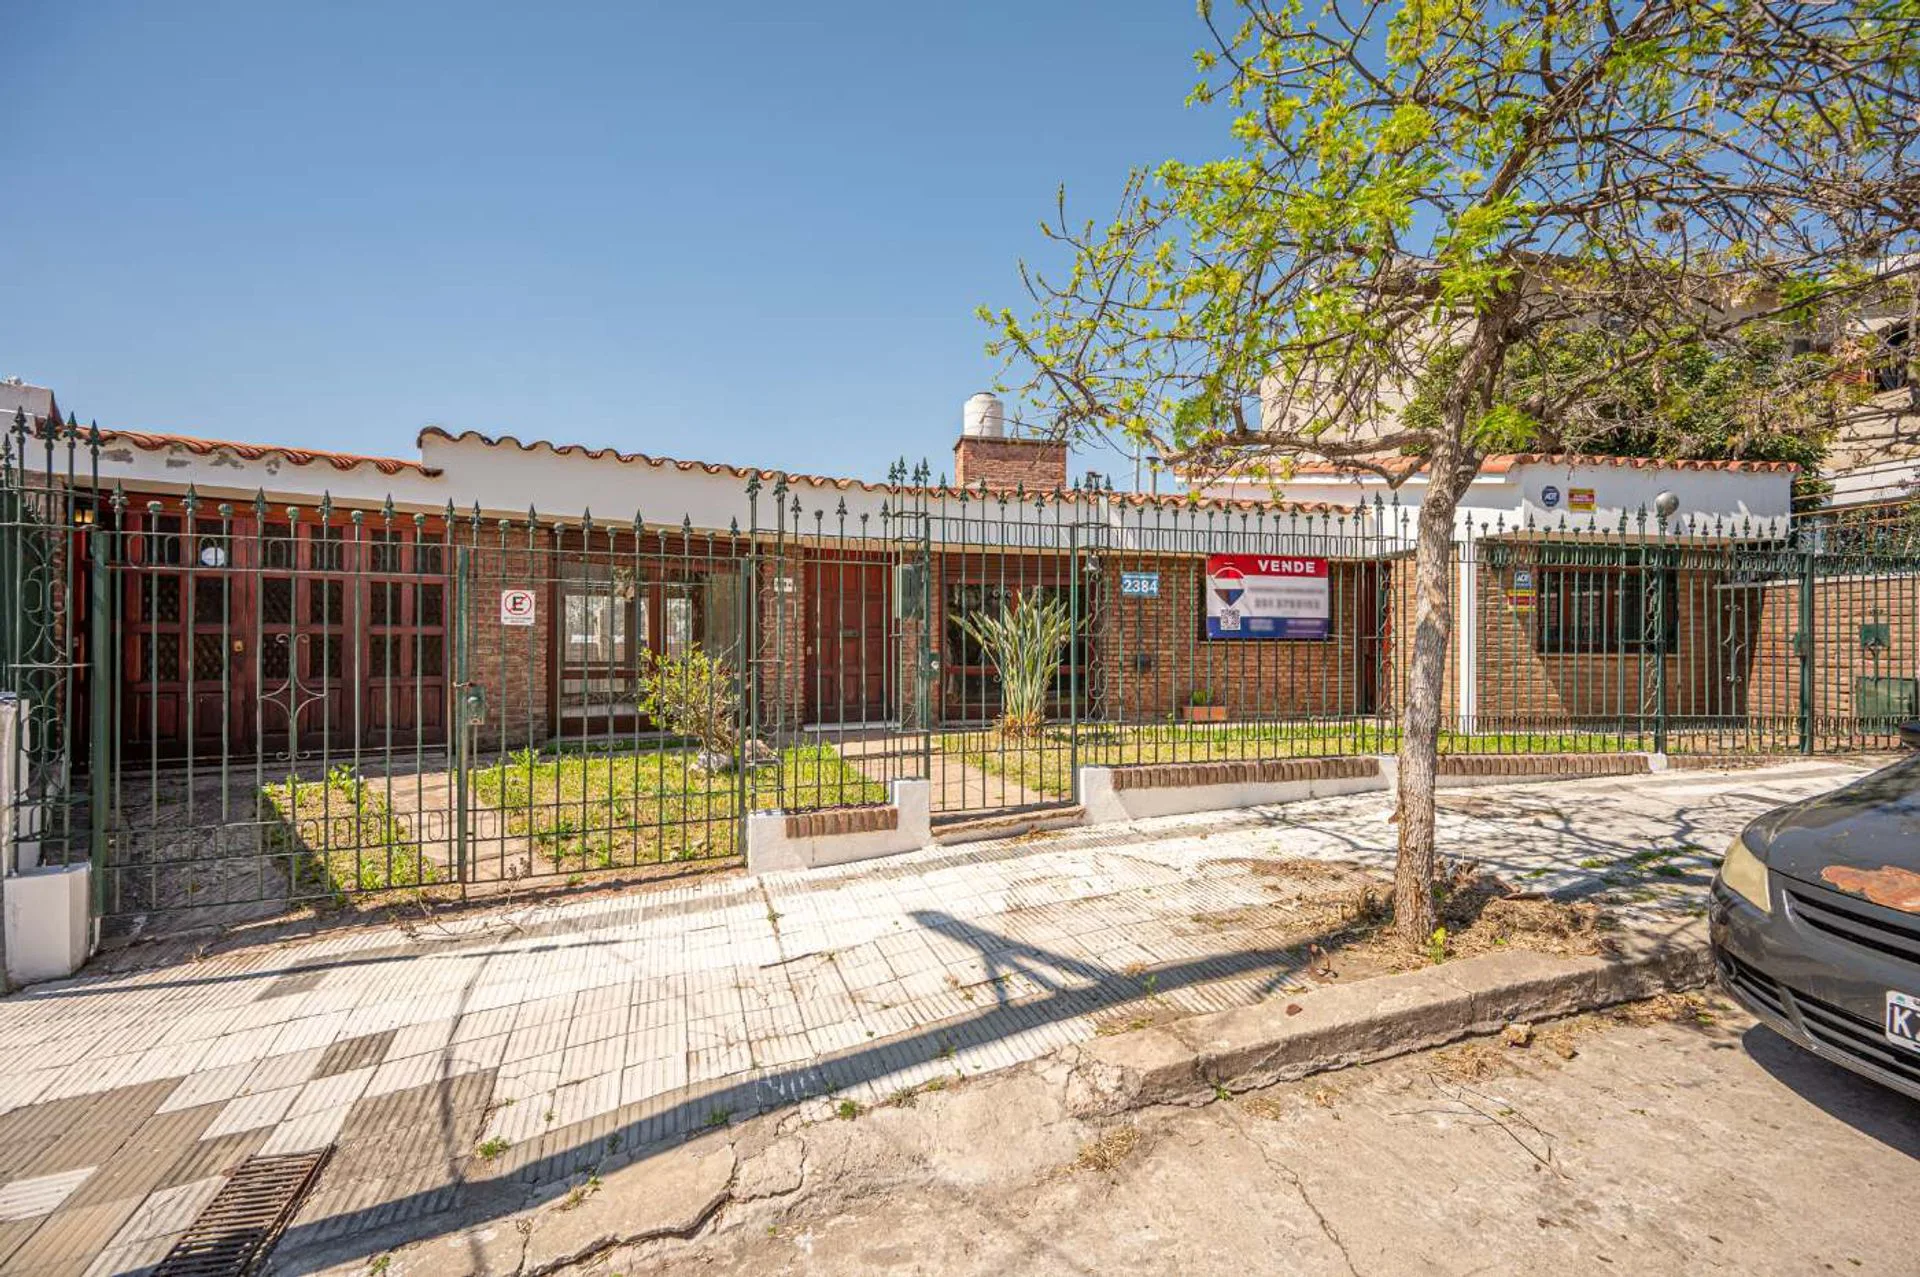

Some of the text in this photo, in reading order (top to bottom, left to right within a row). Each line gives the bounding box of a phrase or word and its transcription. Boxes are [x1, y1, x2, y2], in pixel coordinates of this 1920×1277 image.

[1258, 559, 1315, 573] VENDE
[1123, 579, 1158, 593] 2384
[512, 596, 525, 611] E
